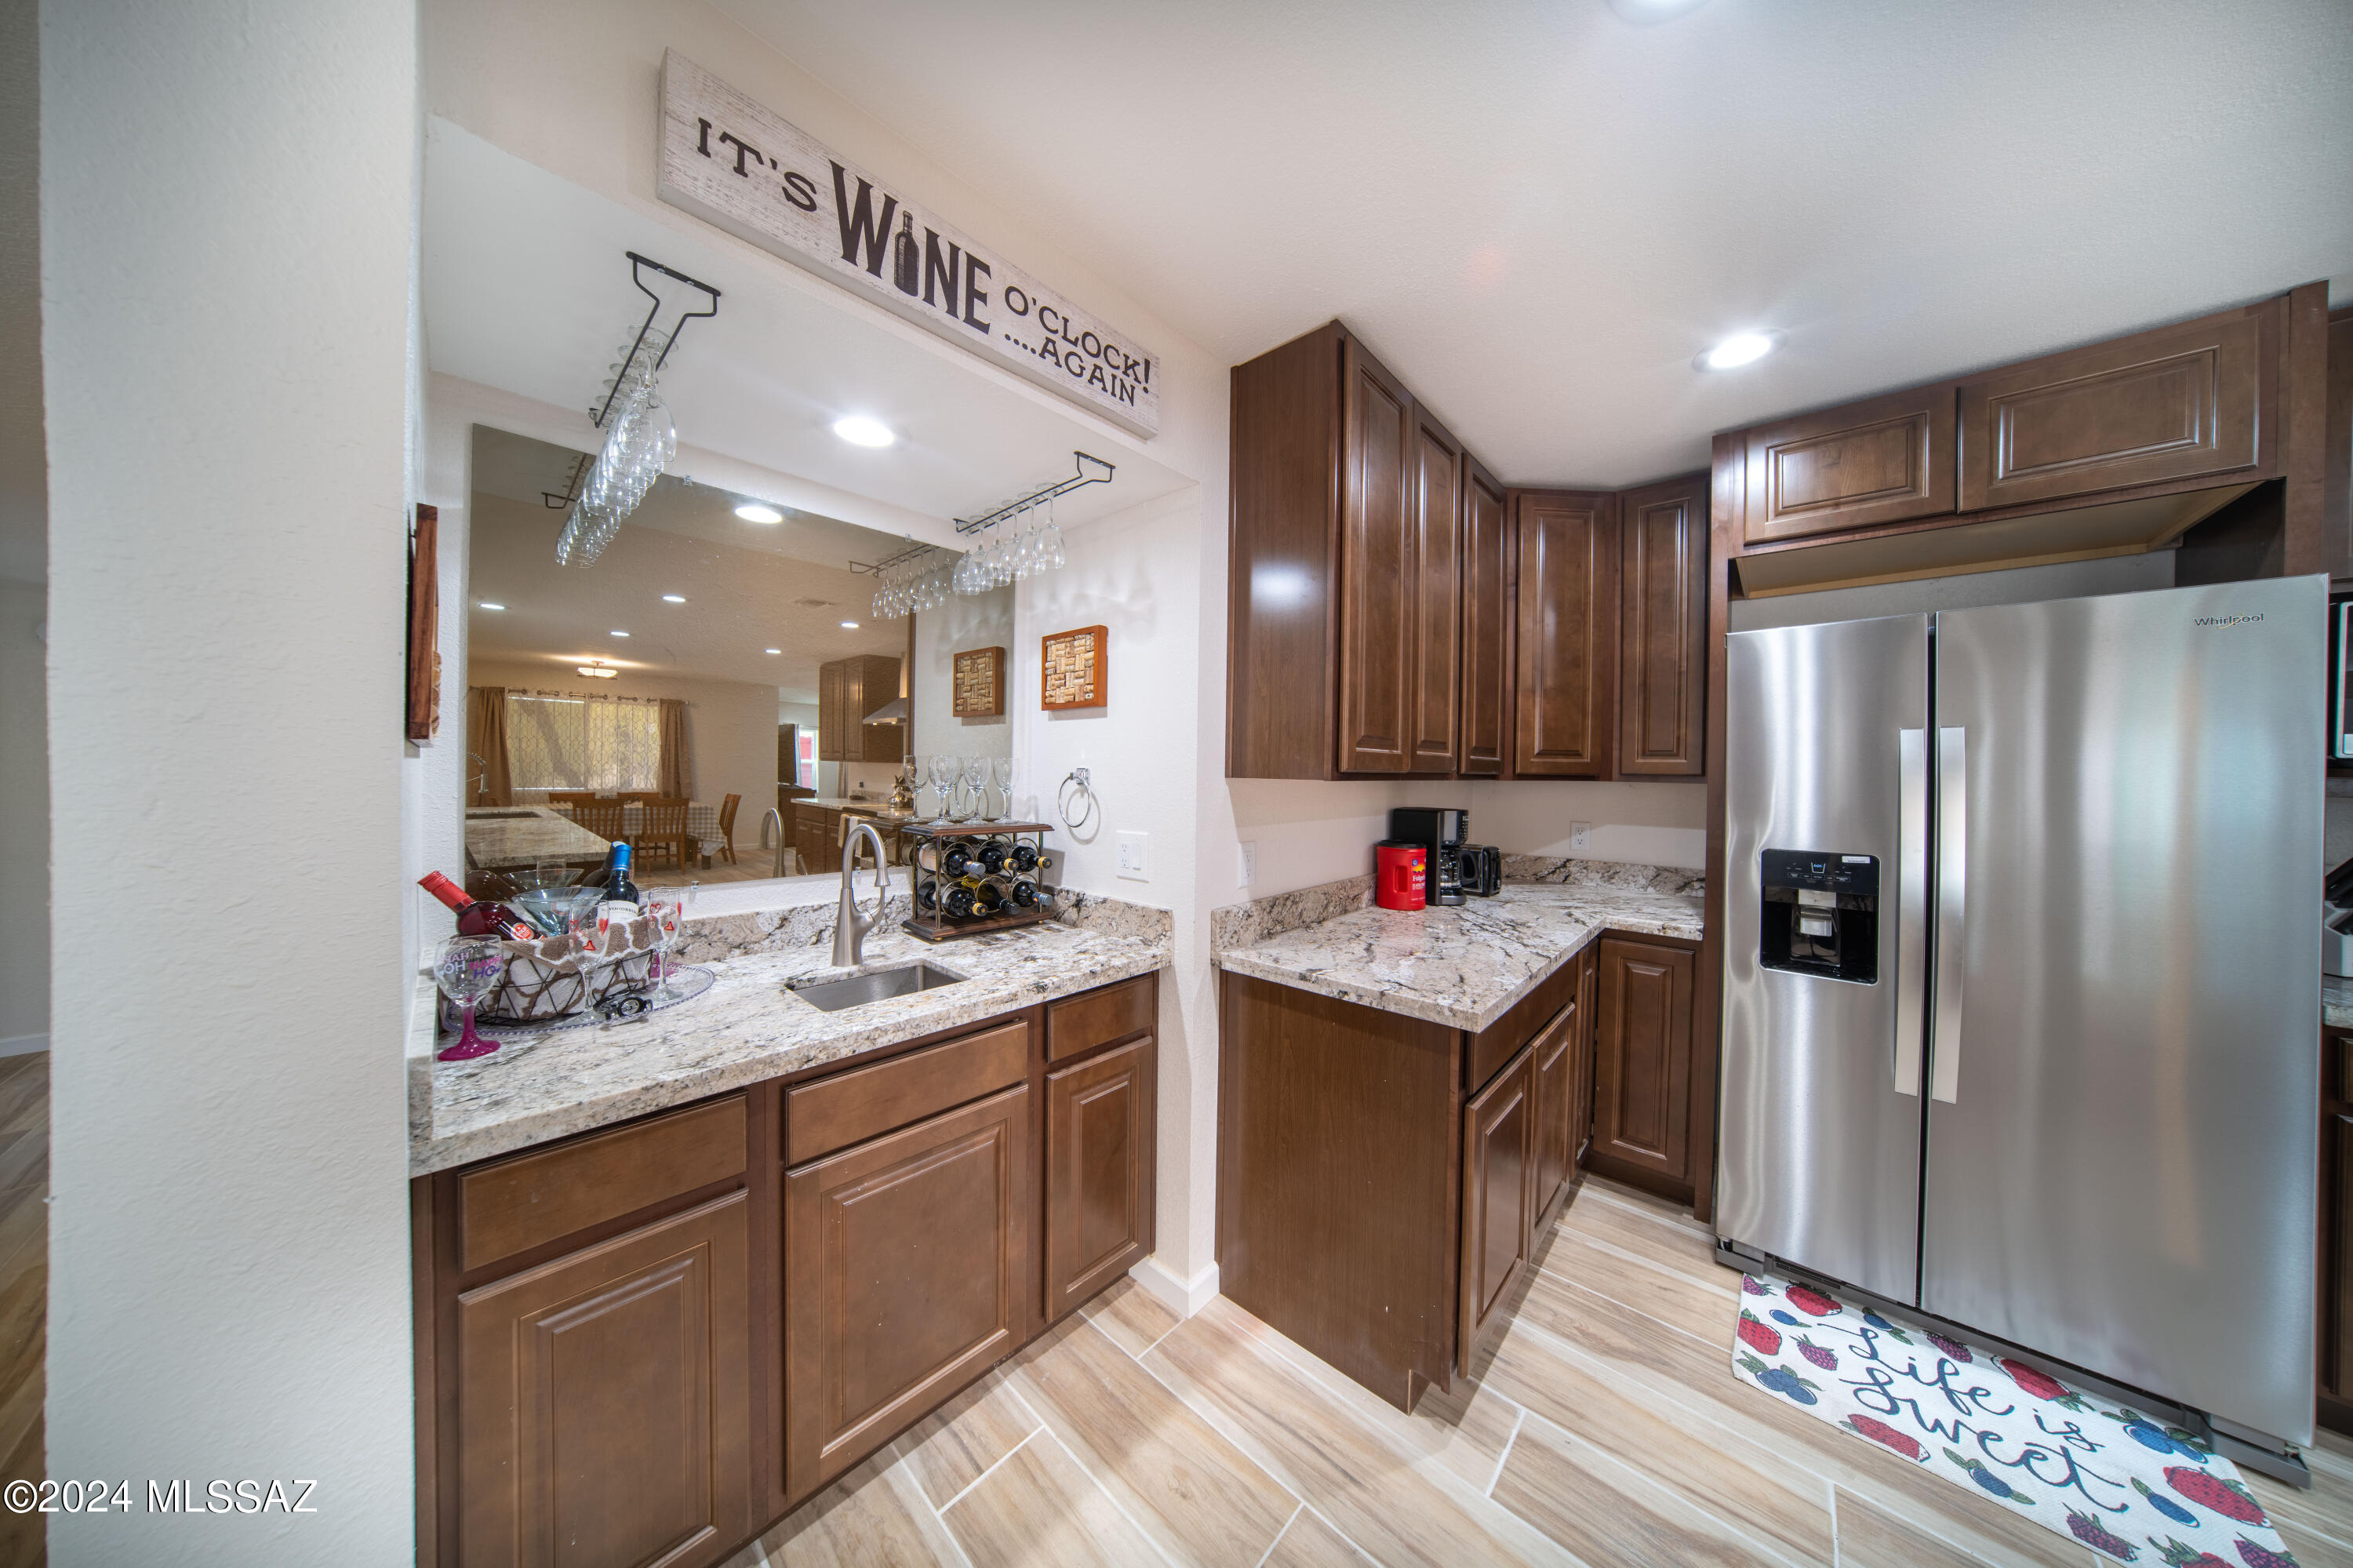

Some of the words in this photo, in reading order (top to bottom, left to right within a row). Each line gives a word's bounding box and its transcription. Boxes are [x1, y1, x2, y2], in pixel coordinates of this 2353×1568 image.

[697, 116, 817, 213] IT'S
[1004, 285, 1151, 394] O'CLOCK!
[2194, 613, 2264, 626] Whirlpool
[1817, 1322, 2015, 1416] Life
[2034, 1408, 2105, 1453] is
